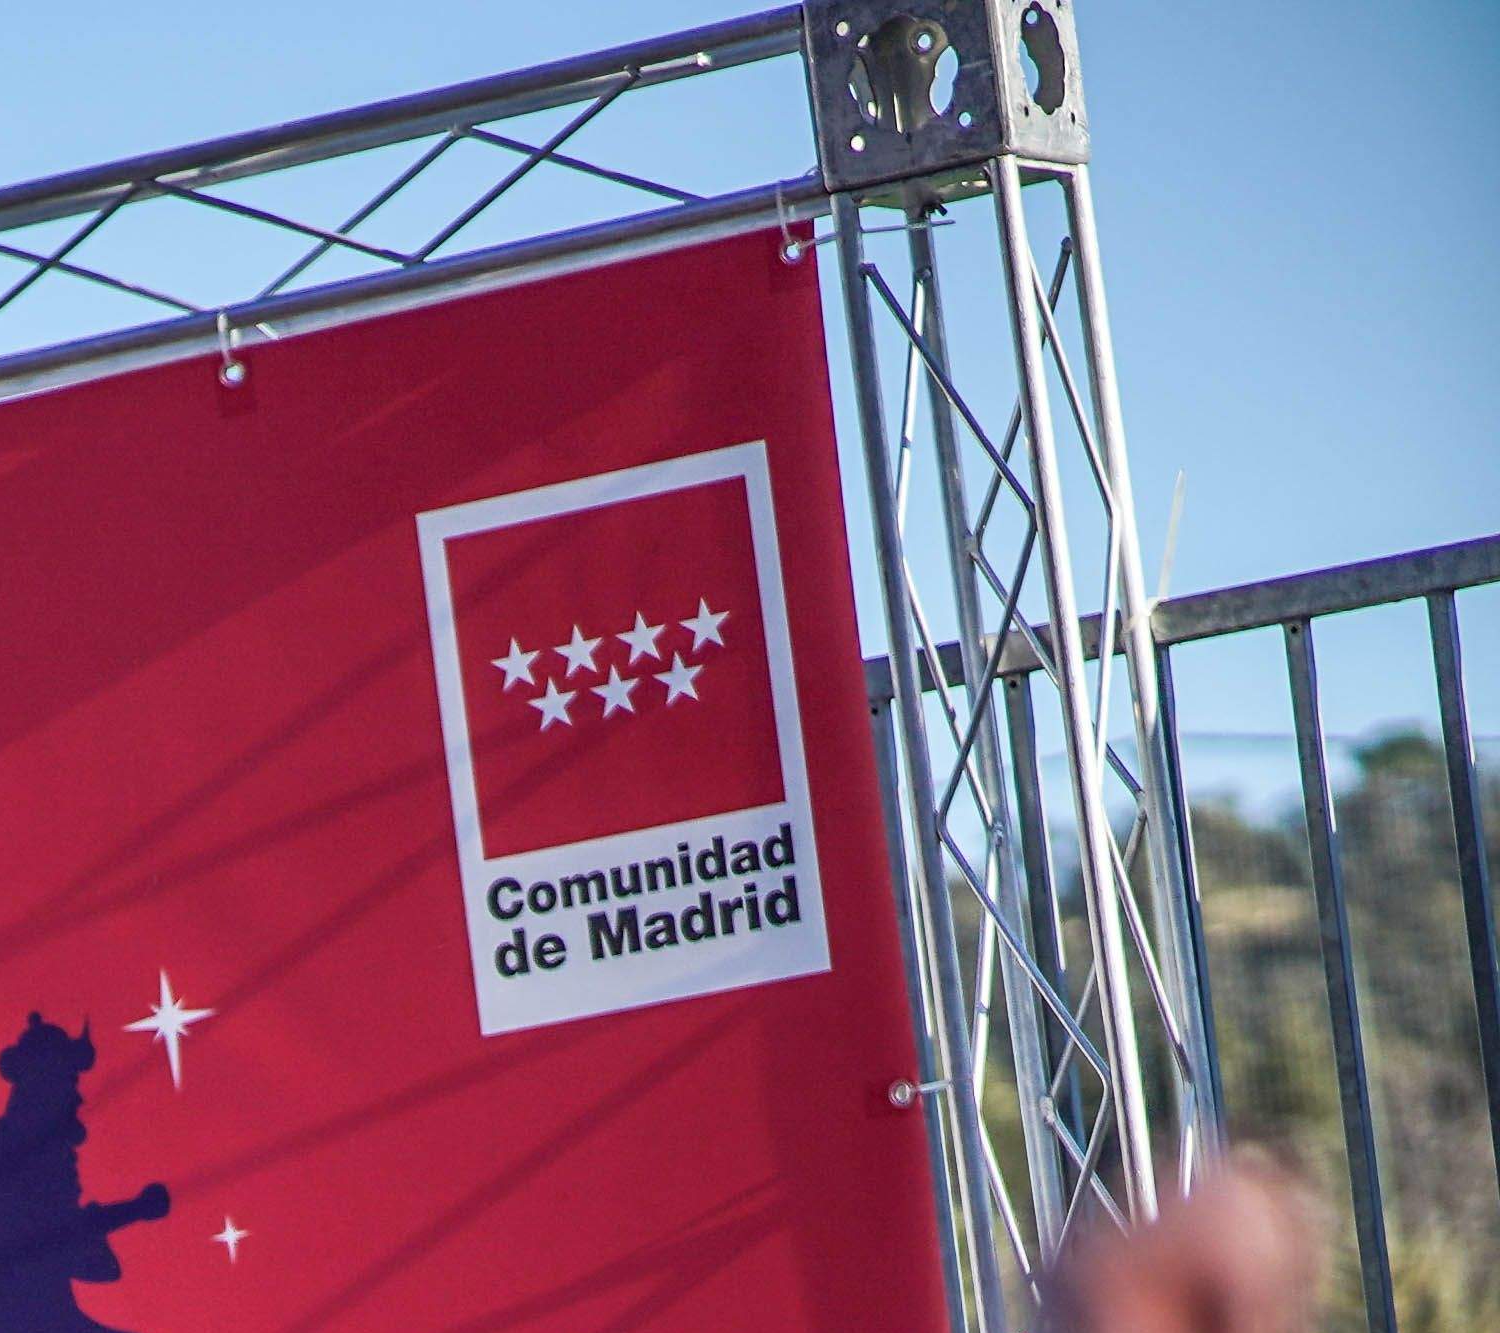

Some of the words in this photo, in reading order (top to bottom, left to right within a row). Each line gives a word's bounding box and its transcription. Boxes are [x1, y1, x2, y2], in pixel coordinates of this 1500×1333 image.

[485, 823, 797, 921] Comunidad
[494, 928, 568, 978] de
[588, 875, 802, 963] Madrid
